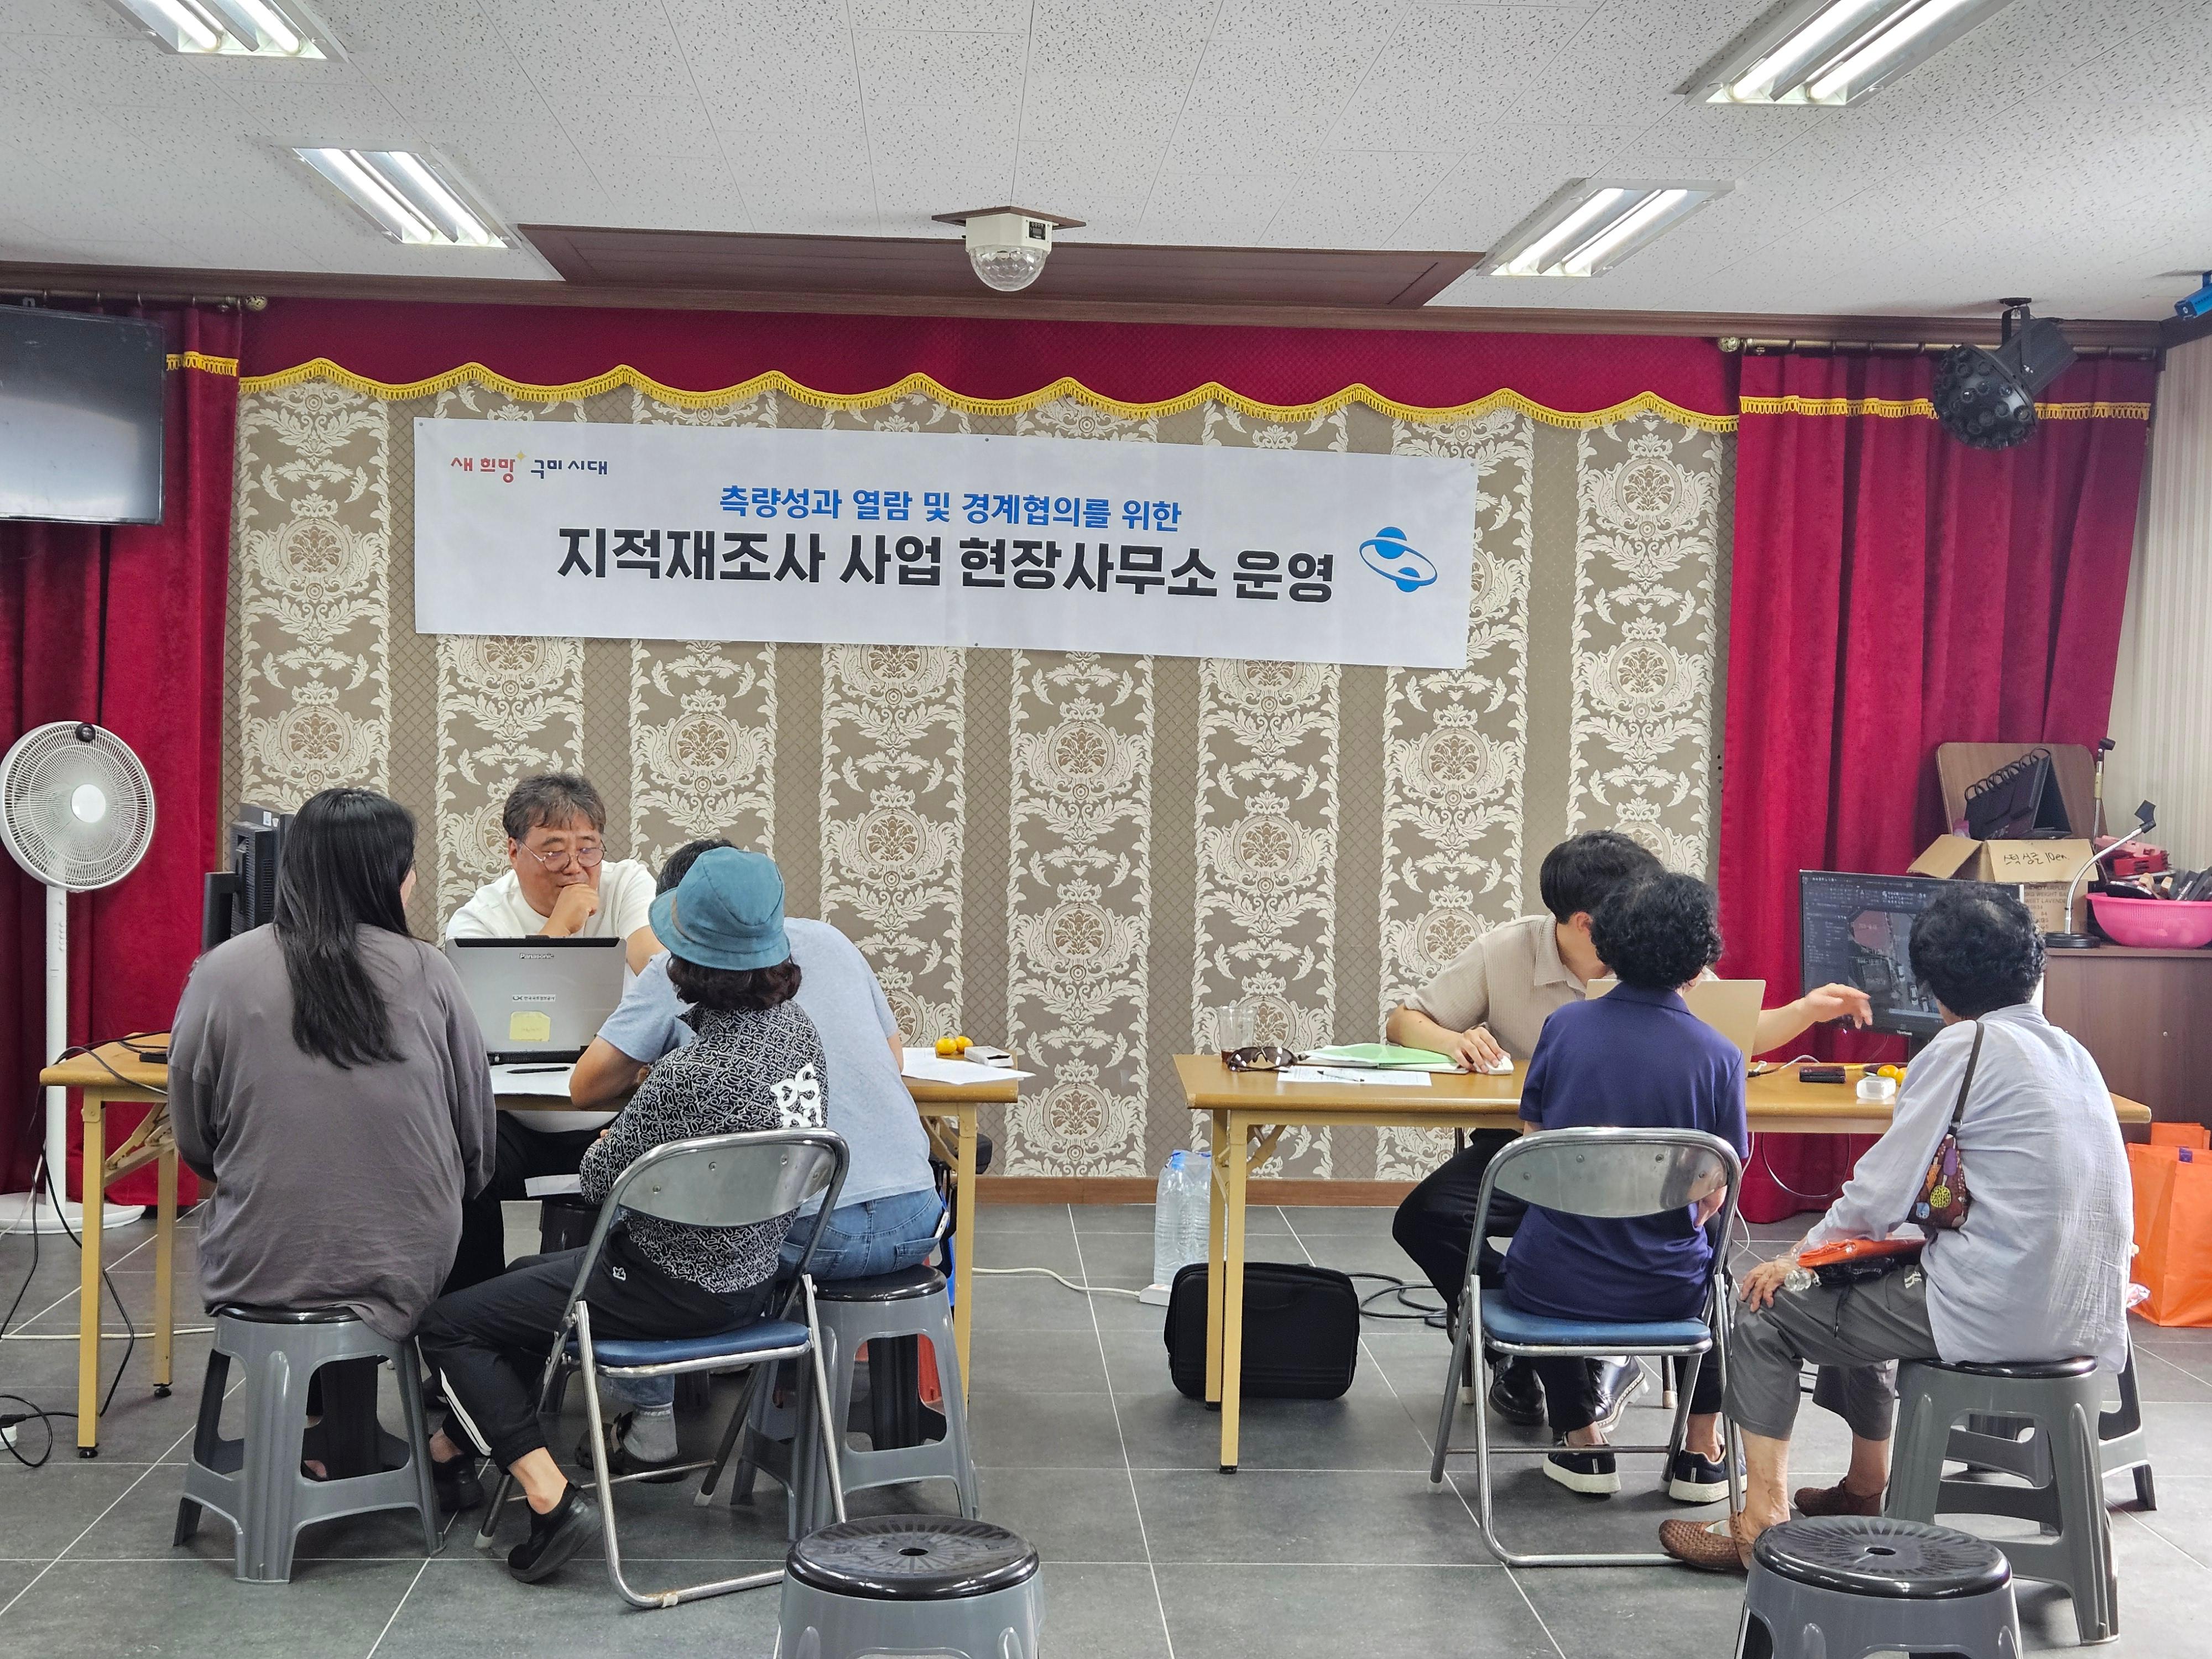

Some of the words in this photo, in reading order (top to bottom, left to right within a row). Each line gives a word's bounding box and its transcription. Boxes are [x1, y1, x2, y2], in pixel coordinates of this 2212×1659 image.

[451, 458, 473, 472] 새
[480, 457, 514, 483] 희망
[530, 459, 563, 479] 구미
[568, 460, 608, 476] 시대
[720, 486, 842, 519] 측량성과
[853, 490, 912, 521] 열람
[924, 492, 950, 522] 및
[963, 493, 1110, 528] 경계협의를
[1123, 500, 1181, 532] 위한
[557, 528, 826, 583] 지적재조사
[839, 535, 941, 586] 사업
[959, 537, 1218, 597] 현장사무소
[1233, 550, 1334, 603] 운영
